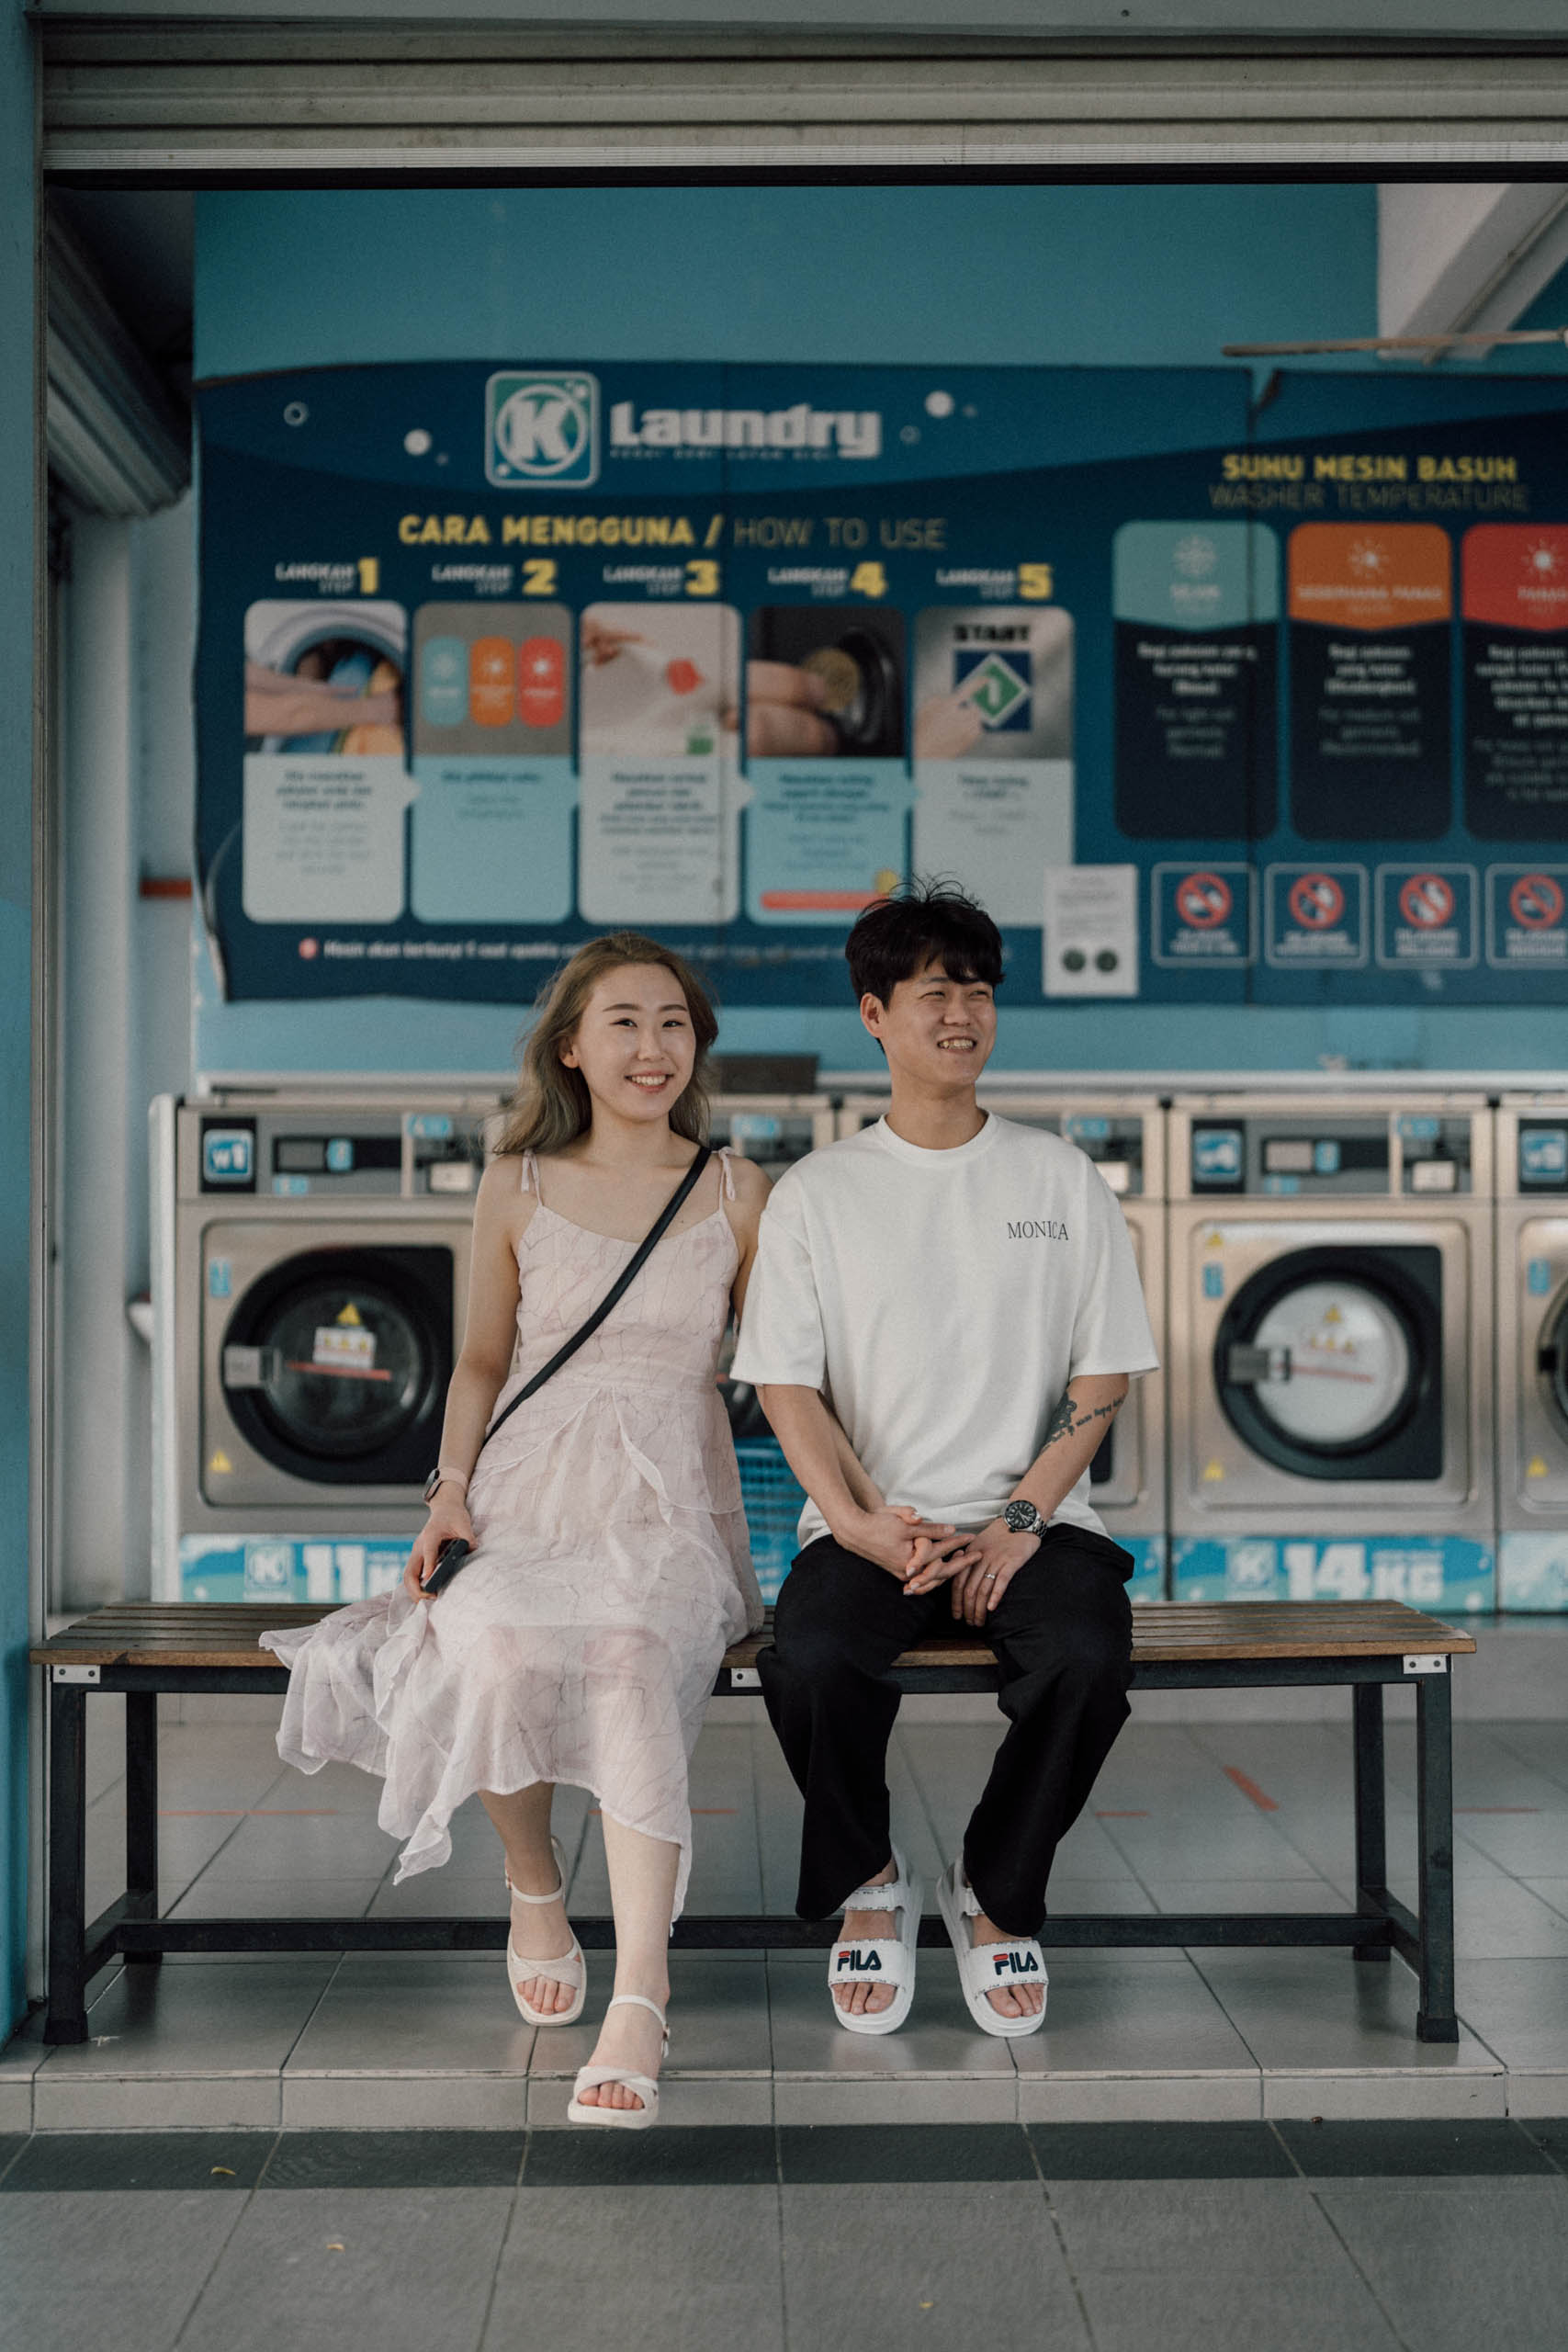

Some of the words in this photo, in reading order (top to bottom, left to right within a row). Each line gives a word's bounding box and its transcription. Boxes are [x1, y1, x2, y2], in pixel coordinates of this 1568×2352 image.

[504, 398, 574, 459] K
[609, 401, 882, 459] Laundry
[1222, 455, 1303, 481] SUHU
[1314, 456, 1407, 481] MESIN
[1417, 456, 1517, 482] BASUH
[1209, 482, 1325, 509] WASHER
[1337, 483, 1529, 512] TEMPERATURE
[398, 514, 489, 547] CARA
[502, 515, 694, 548] MENGGUNA
[734, 517, 812, 548] HOW
[827, 518, 868, 548] TO
[881, 518, 947, 549] USE
[358, 557, 379, 594] 1
[522, 558, 558, 594] 2
[684, 559, 720, 595] 3
[850, 560, 887, 598] 4
[1018, 562, 1053, 600] 5
[953, 626, 1030, 641] START
[1007, 1220, 1068, 1240] MONICA
[302, 1544, 366, 1600] 11
[1284, 1544, 1371, 1600] 14
[1372, 1564, 1444, 1601] KG
[837, 1950, 882, 1972] FILA
[993, 1951, 1039, 1975] FILA
